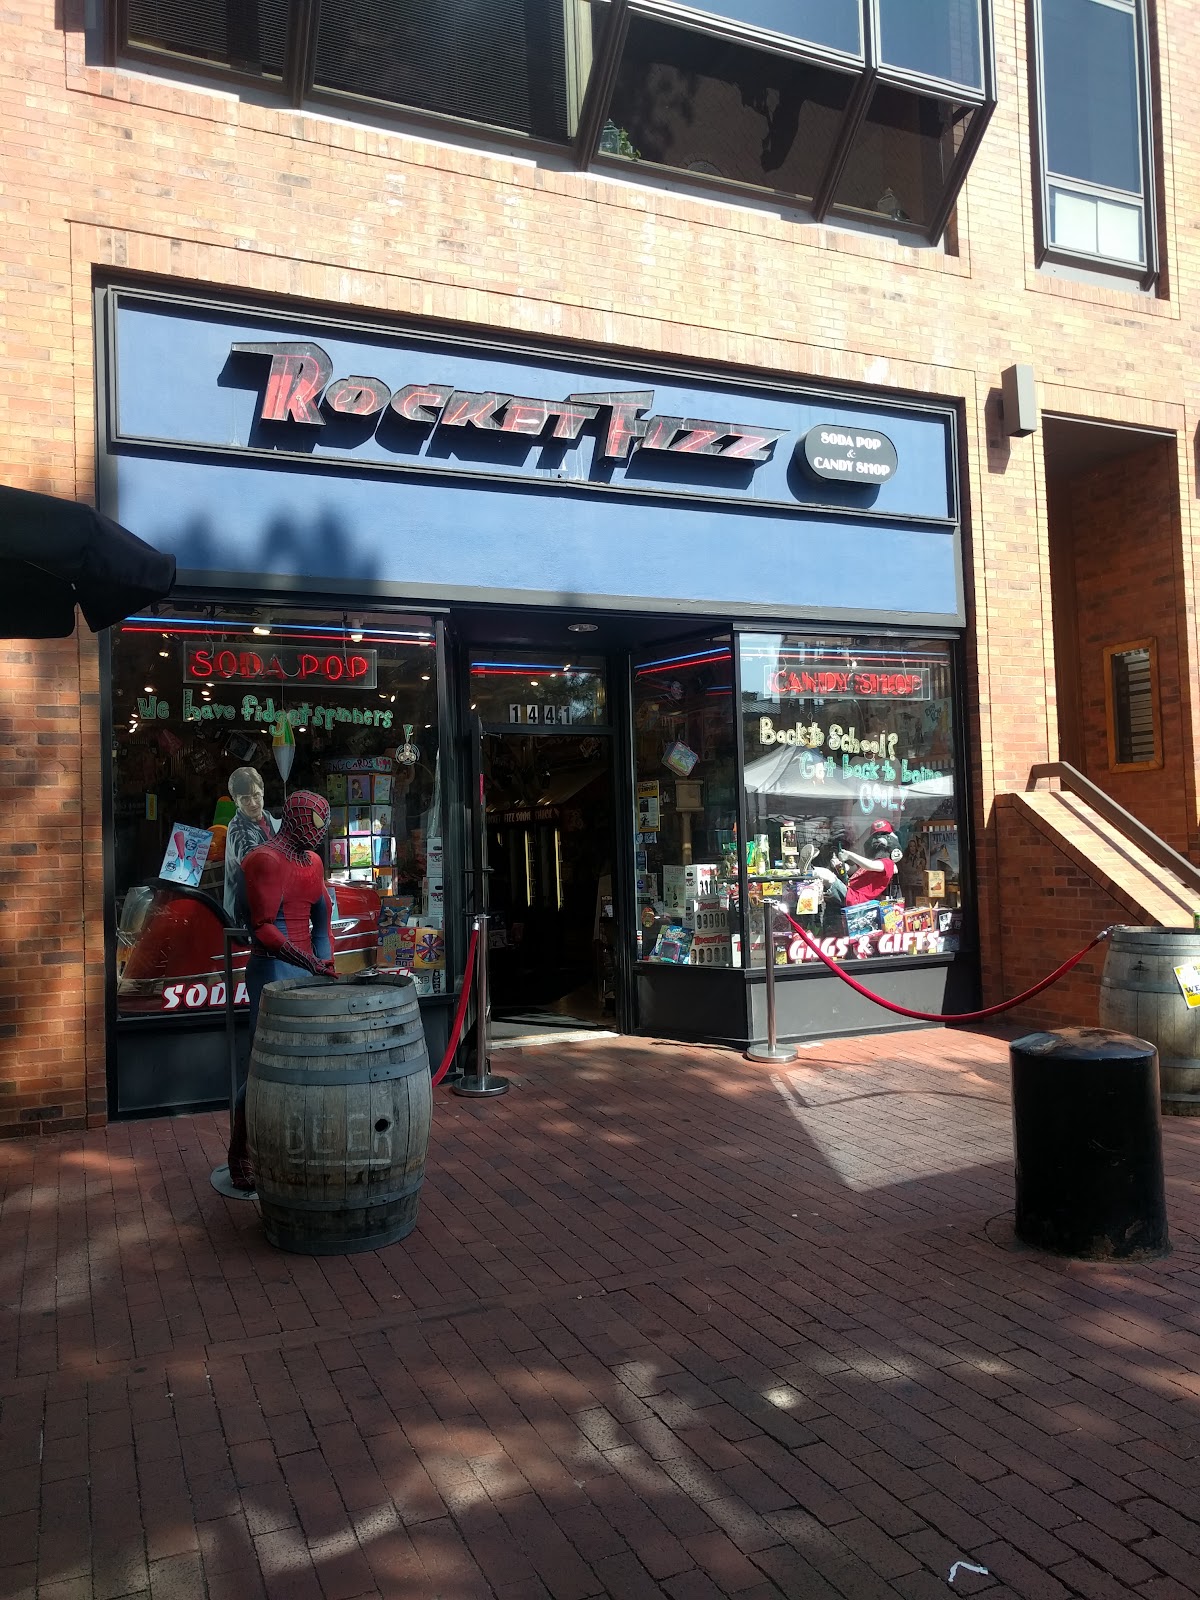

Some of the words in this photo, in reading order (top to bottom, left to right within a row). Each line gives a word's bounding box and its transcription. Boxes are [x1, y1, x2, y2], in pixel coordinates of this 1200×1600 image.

[231, 341, 600, 440] ROCKET
[568, 389, 791, 461] FIZZ
[821, 432, 854, 447] SODA
[856, 436, 881, 450] POP
[846, 449, 856, 458] &
[813, 457, 854, 472] CANDY
[856, 462, 890, 476] SHOP
[191, 651, 284, 679] SODA
[300, 654, 368, 680] POP
[769, 671, 852, 694] CANDY
[856, 672, 923, 695] SHOP
[138, 695, 170, 720] We
[183, 688, 236, 722] have
[241, 694, 312, 737] fidget
[312, 705, 394, 731] spinners
[511, 705, 571, 724] 1441
[759, 716, 806, 747] Back
[842, 753, 880, 780] back
[882, 759, 896, 782] to
[932, 832, 957, 842] TITANIC
[878, 931, 940, 955] GIFTS
[162, 981, 250, 1010] SODA
